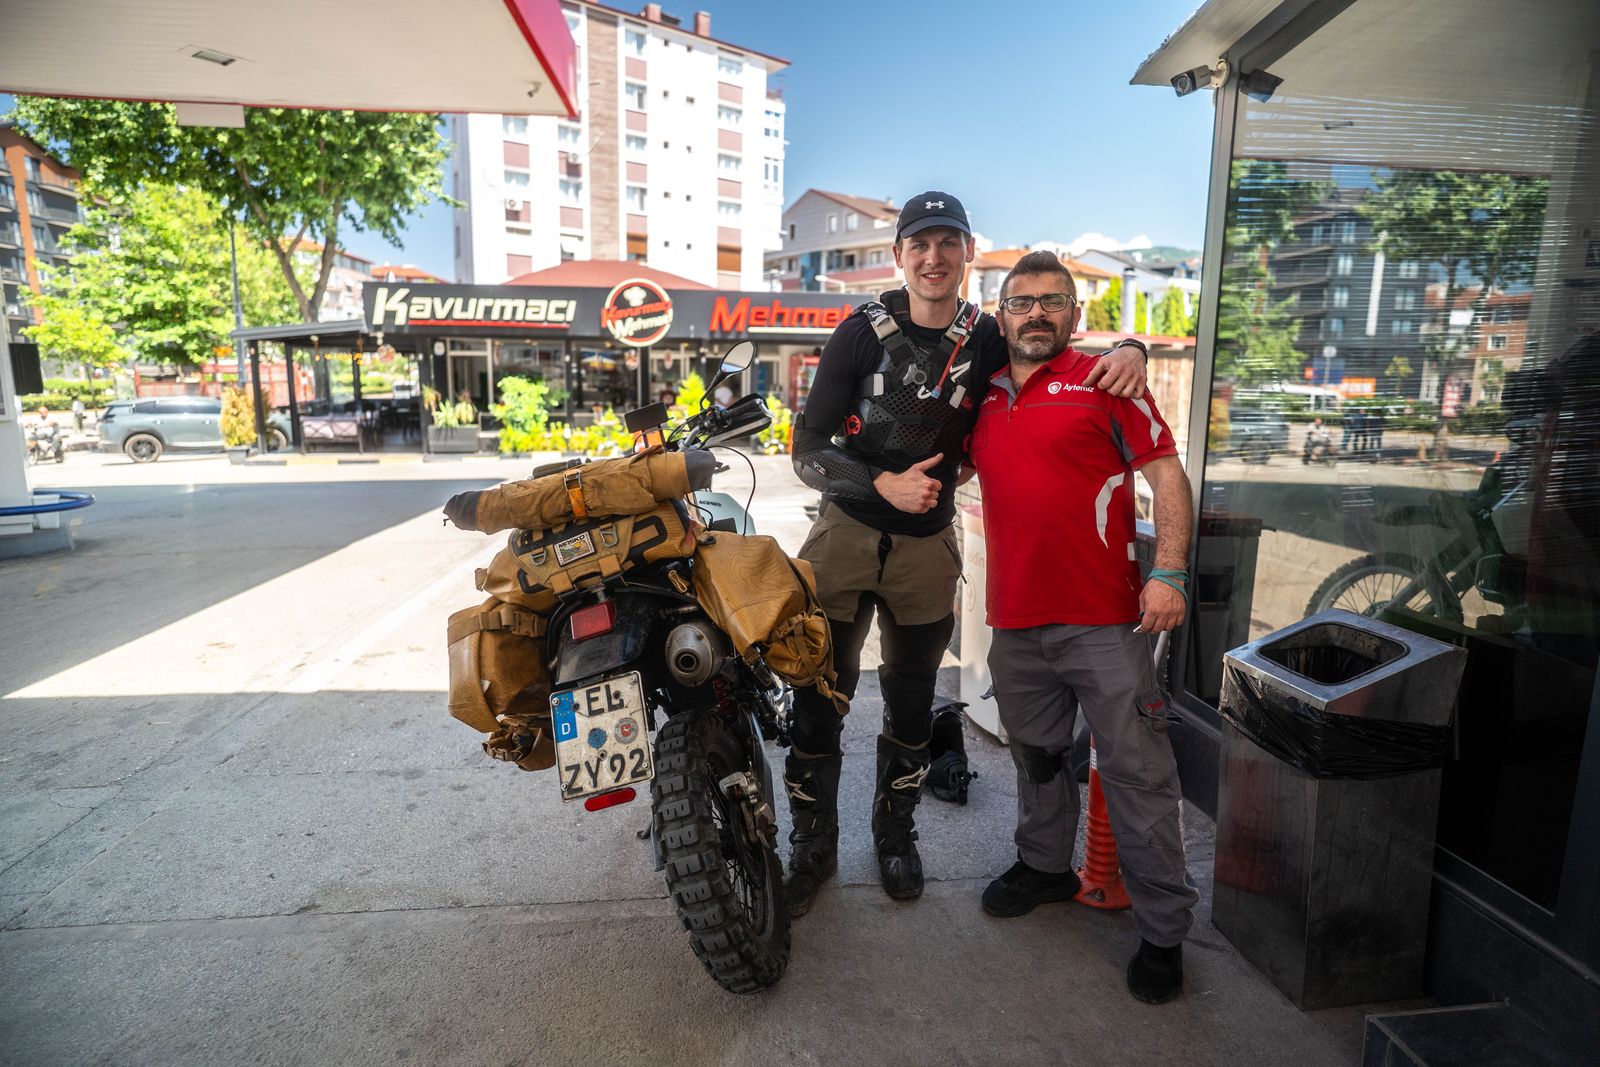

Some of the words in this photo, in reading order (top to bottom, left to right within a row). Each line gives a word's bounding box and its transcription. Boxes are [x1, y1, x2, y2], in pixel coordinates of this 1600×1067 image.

[372, 287, 577, 326] Kavurmacı
[1063, 383, 1094, 393] Aytemiz
[585, 683, 625, 718] EL
[561, 722, 571, 735] D
